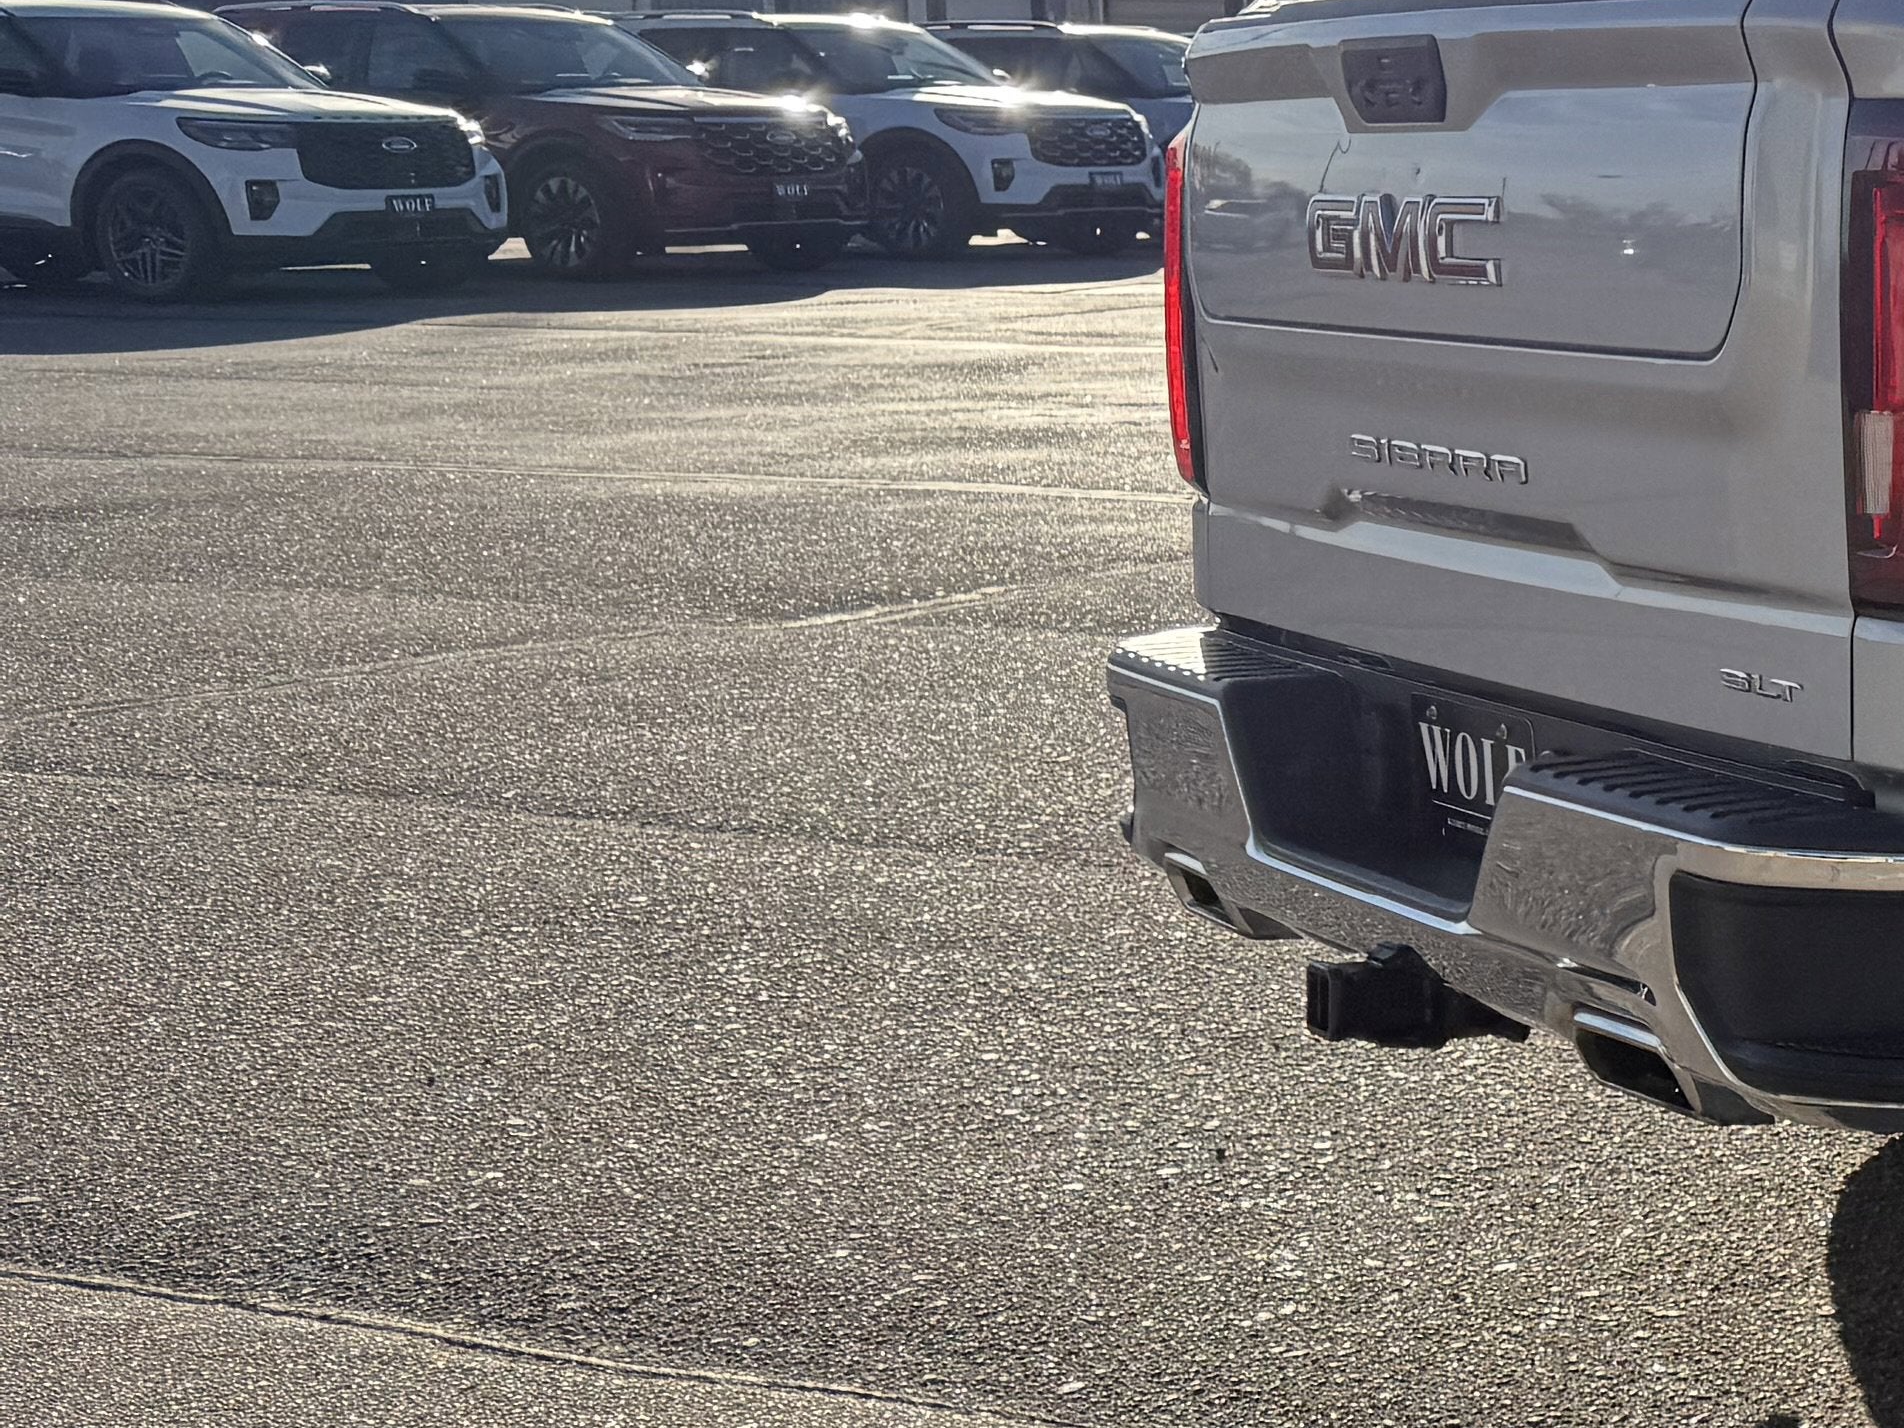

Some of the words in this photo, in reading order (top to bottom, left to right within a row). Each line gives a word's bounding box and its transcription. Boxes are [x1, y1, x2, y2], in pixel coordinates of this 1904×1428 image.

[1306, 193, 1503, 287] GMC
[1350, 433, 1528, 484] SIERRA
[1720, 668, 1804, 702] SLT
